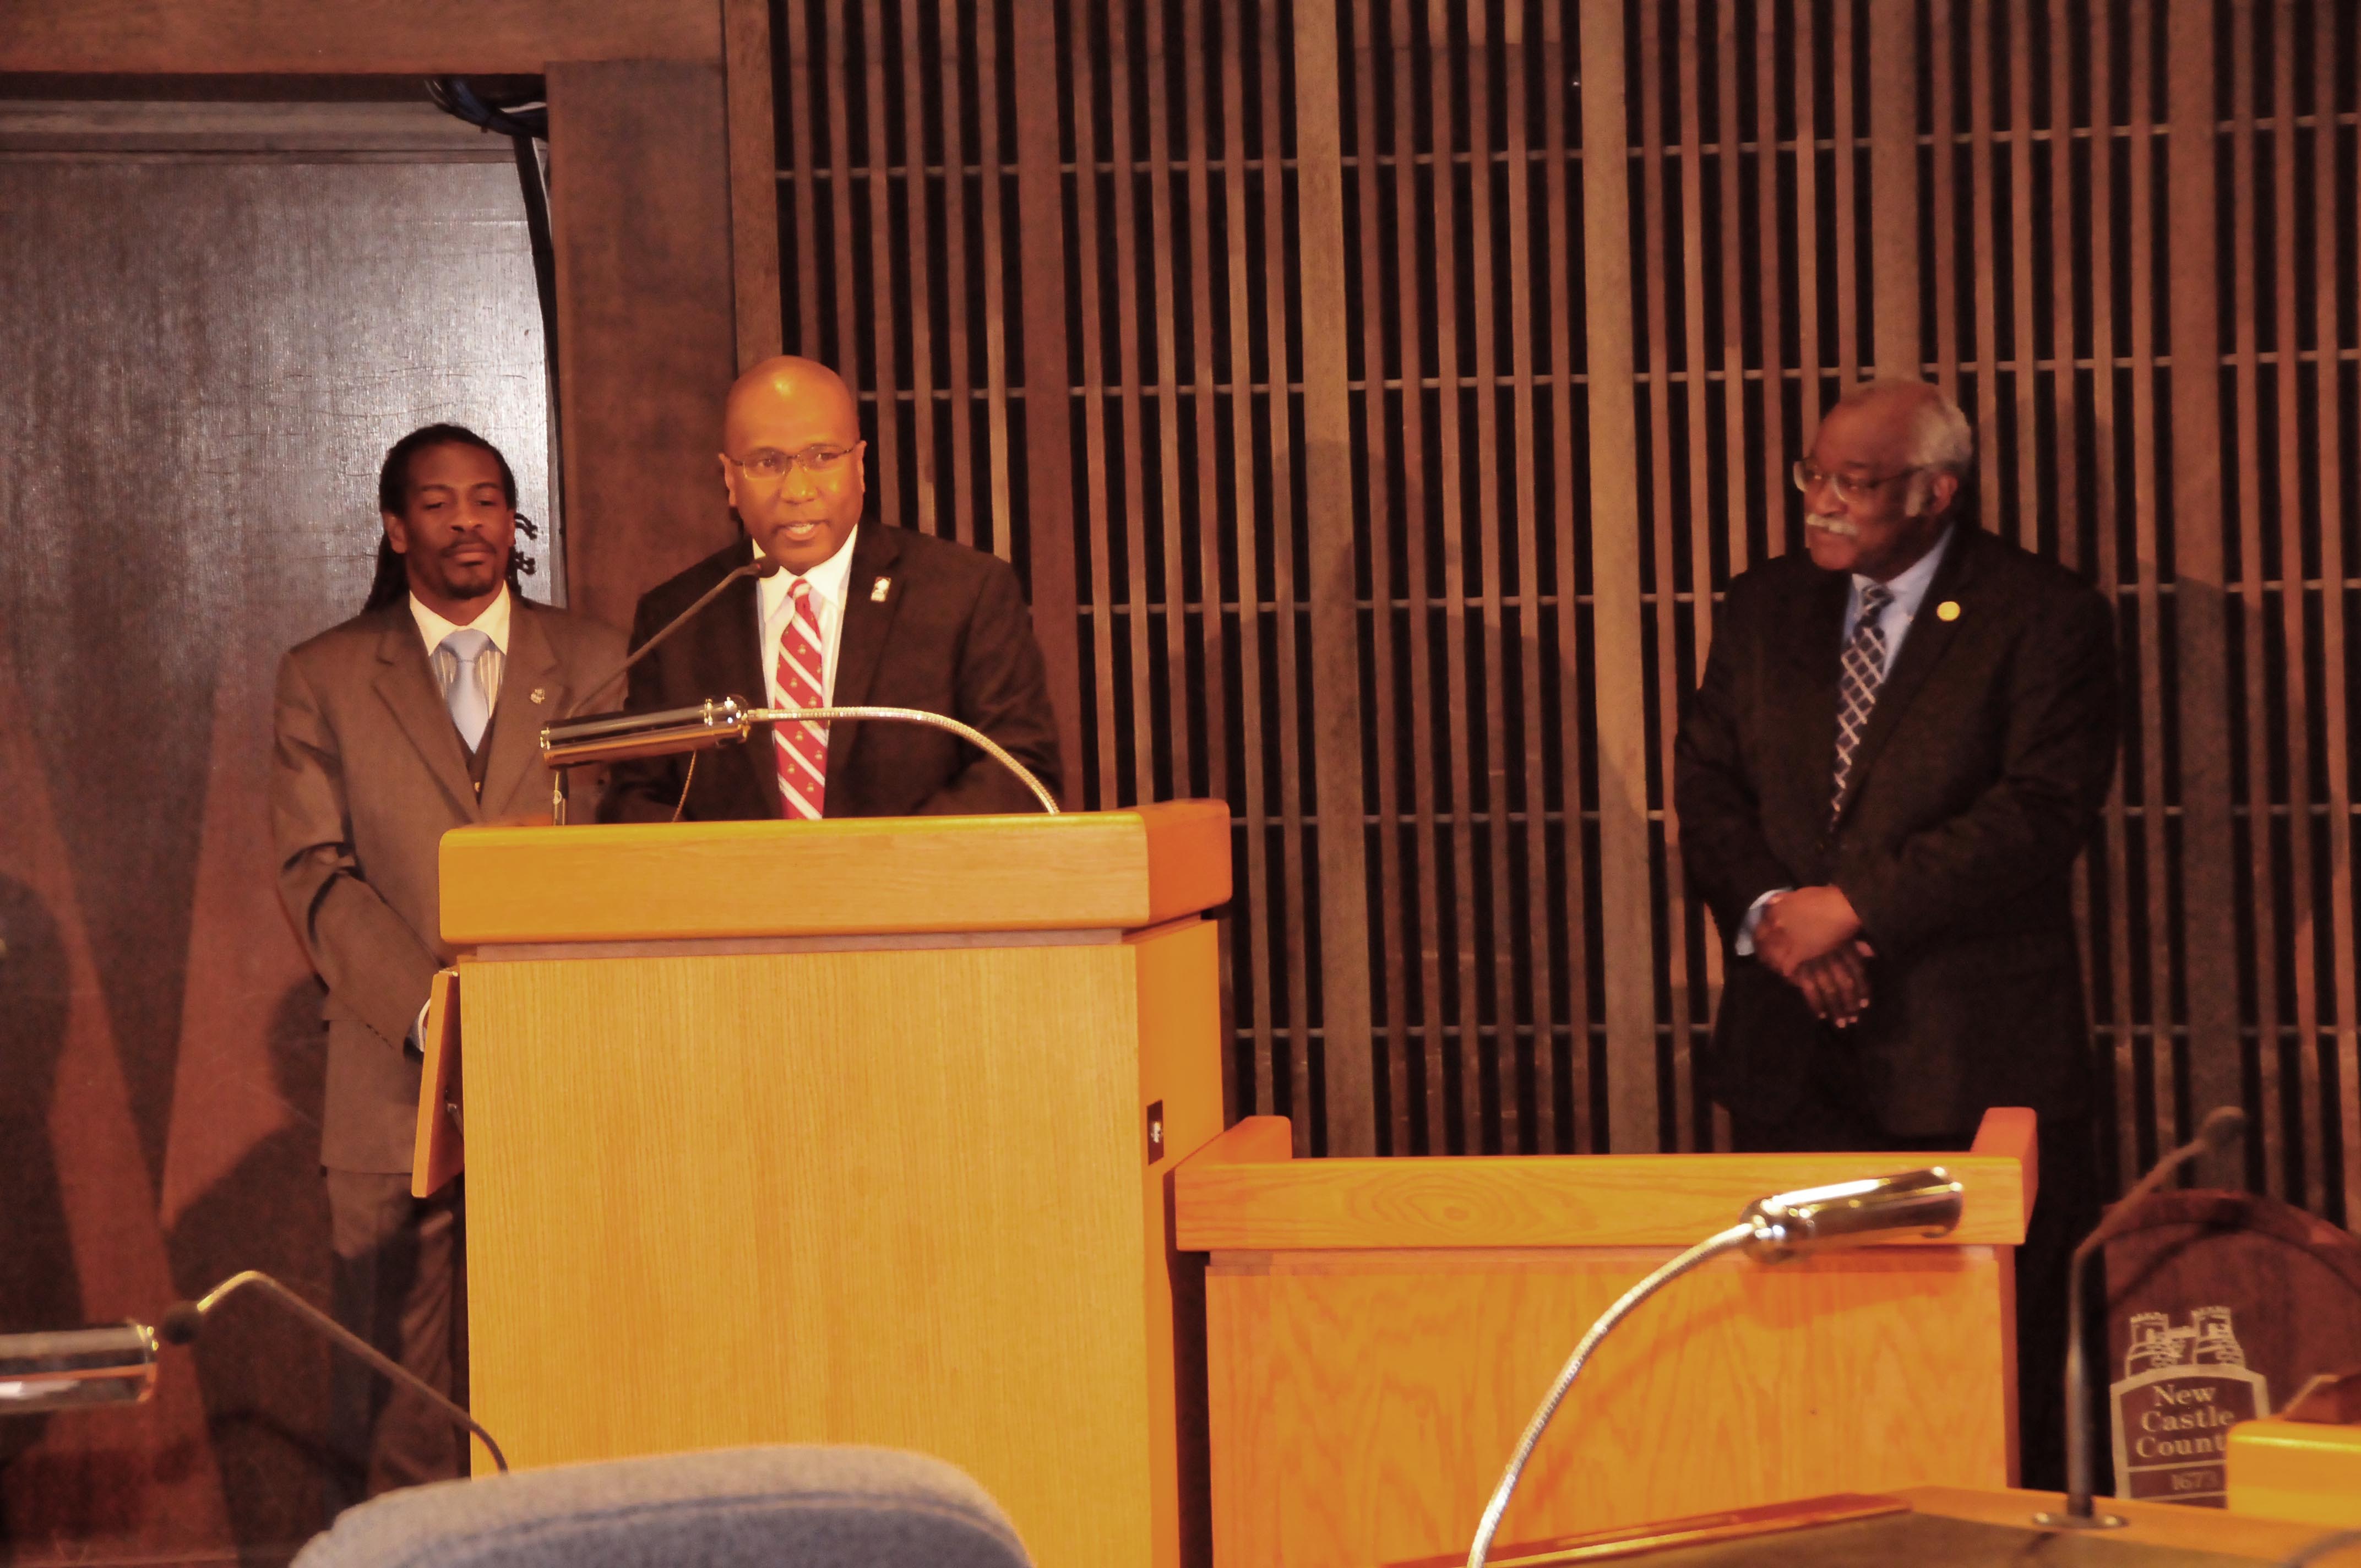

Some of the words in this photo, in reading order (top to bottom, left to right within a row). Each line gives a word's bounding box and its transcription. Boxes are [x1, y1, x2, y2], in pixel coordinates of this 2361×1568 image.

[2153, 1384, 2217, 1407] New
[2141, 1406, 2234, 1432] Castle
[2136, 1432, 2226, 1458] Count
